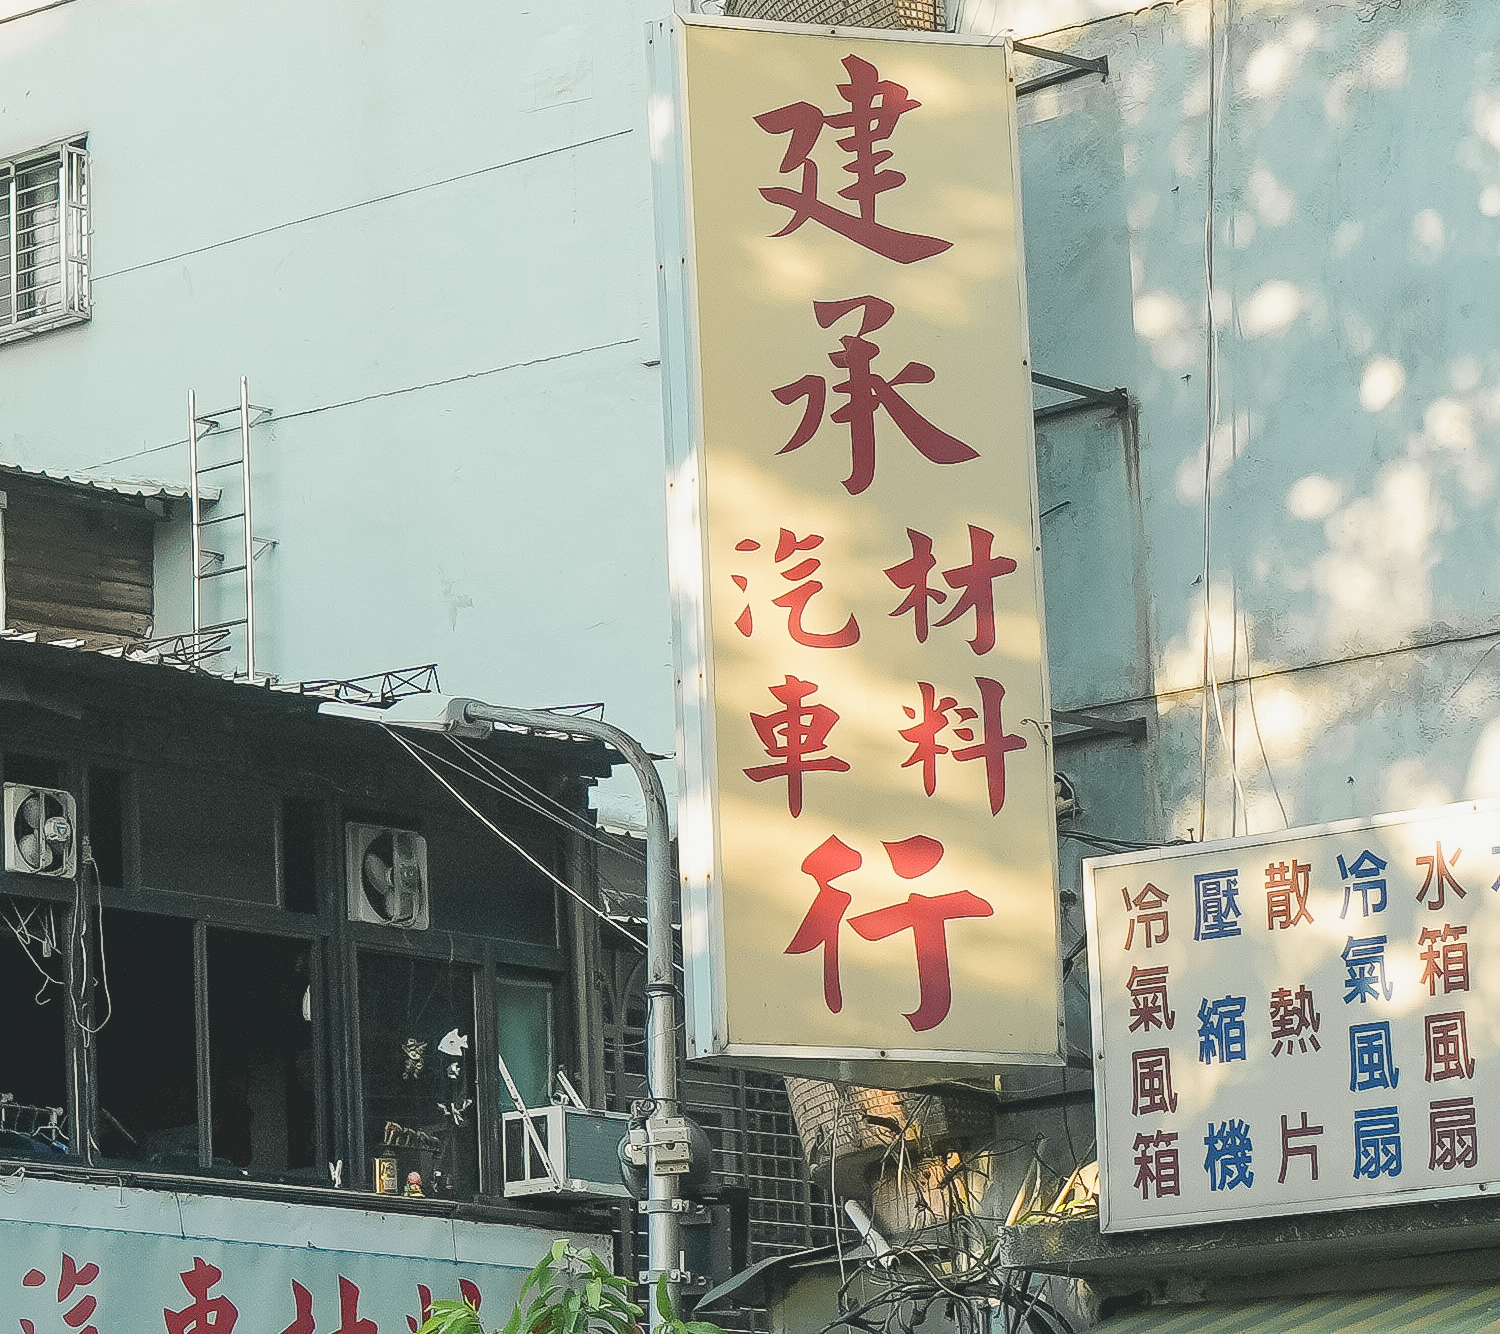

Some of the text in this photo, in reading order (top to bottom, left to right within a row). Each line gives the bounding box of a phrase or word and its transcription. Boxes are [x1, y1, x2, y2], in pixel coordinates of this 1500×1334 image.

[753, 53, 981, 495] 建承
[731, 528, 861, 819] 汽車
[885, 524, 1028, 816] 材料
[784, 834, 995, 1033] 行
[1122, 882, 1182, 1200] 冷氣風箱
[1193, 868, 1255, 1191] 壓縮機
[1264, 859, 1321, 1184] 散熱片
[1336, 849, 1403, 1179] 冷氣風扇
[1415, 840, 1478, 1171] 水箱風扇
